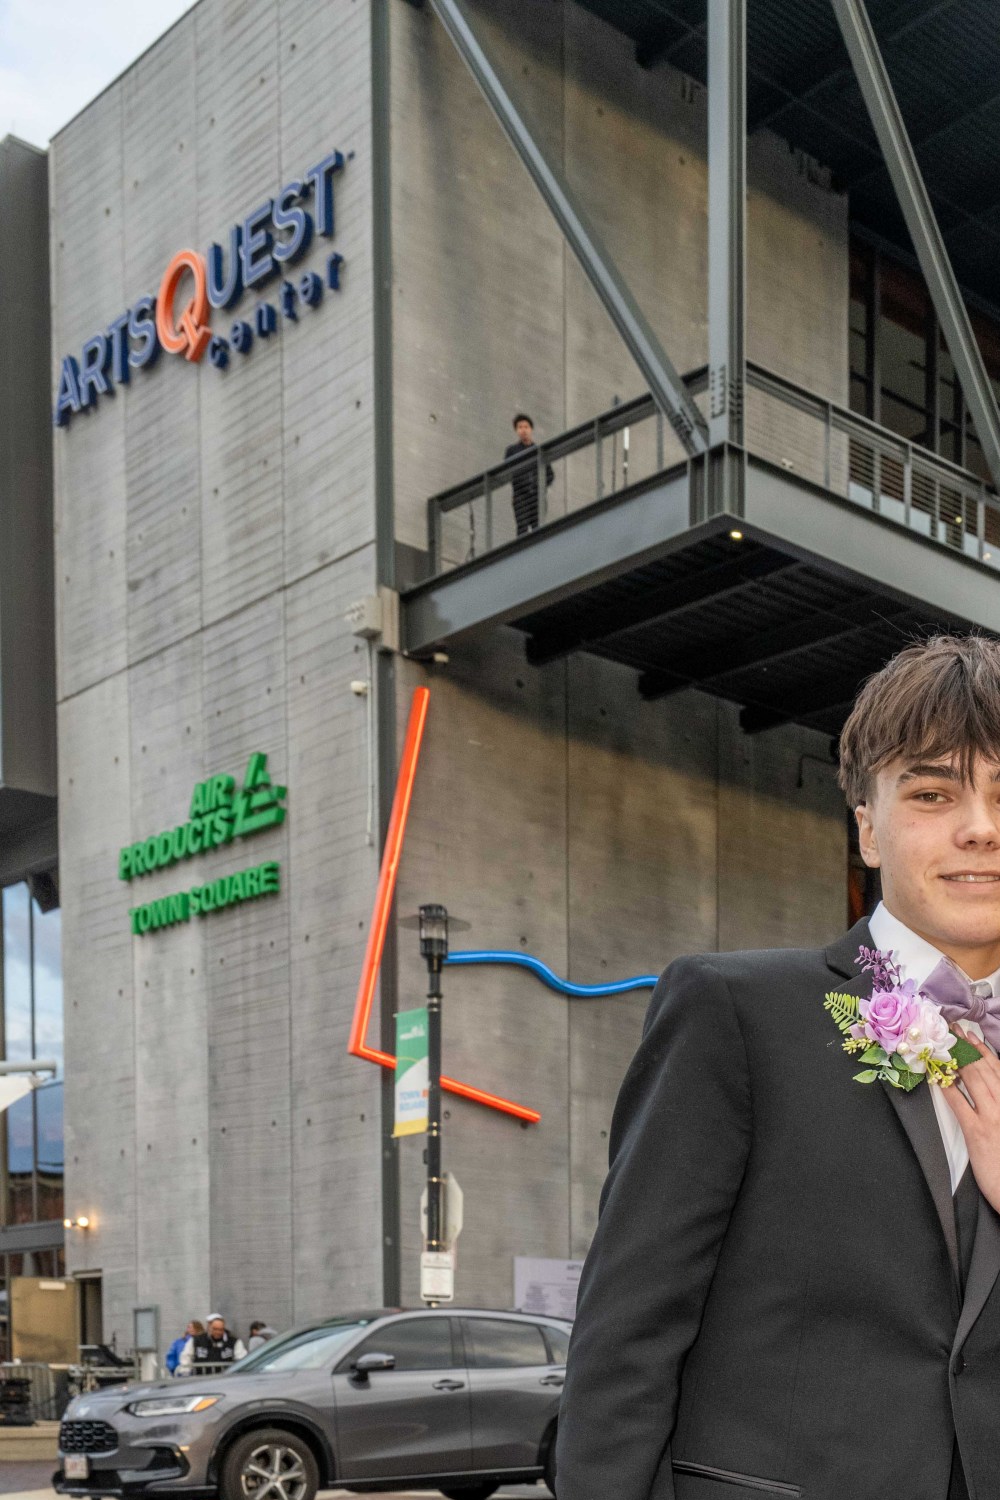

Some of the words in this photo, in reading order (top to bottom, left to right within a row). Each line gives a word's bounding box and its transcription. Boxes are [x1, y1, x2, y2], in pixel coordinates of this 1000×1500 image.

[54, 148, 345, 427] ARTSQUEST
[207, 252, 345, 370] center
[190, 773, 235, 821] AIR
[118, 807, 236, 881] PRODUCTS
[129, 892, 193, 935] TOWN
[189, 861, 280, 914] SQUARE
